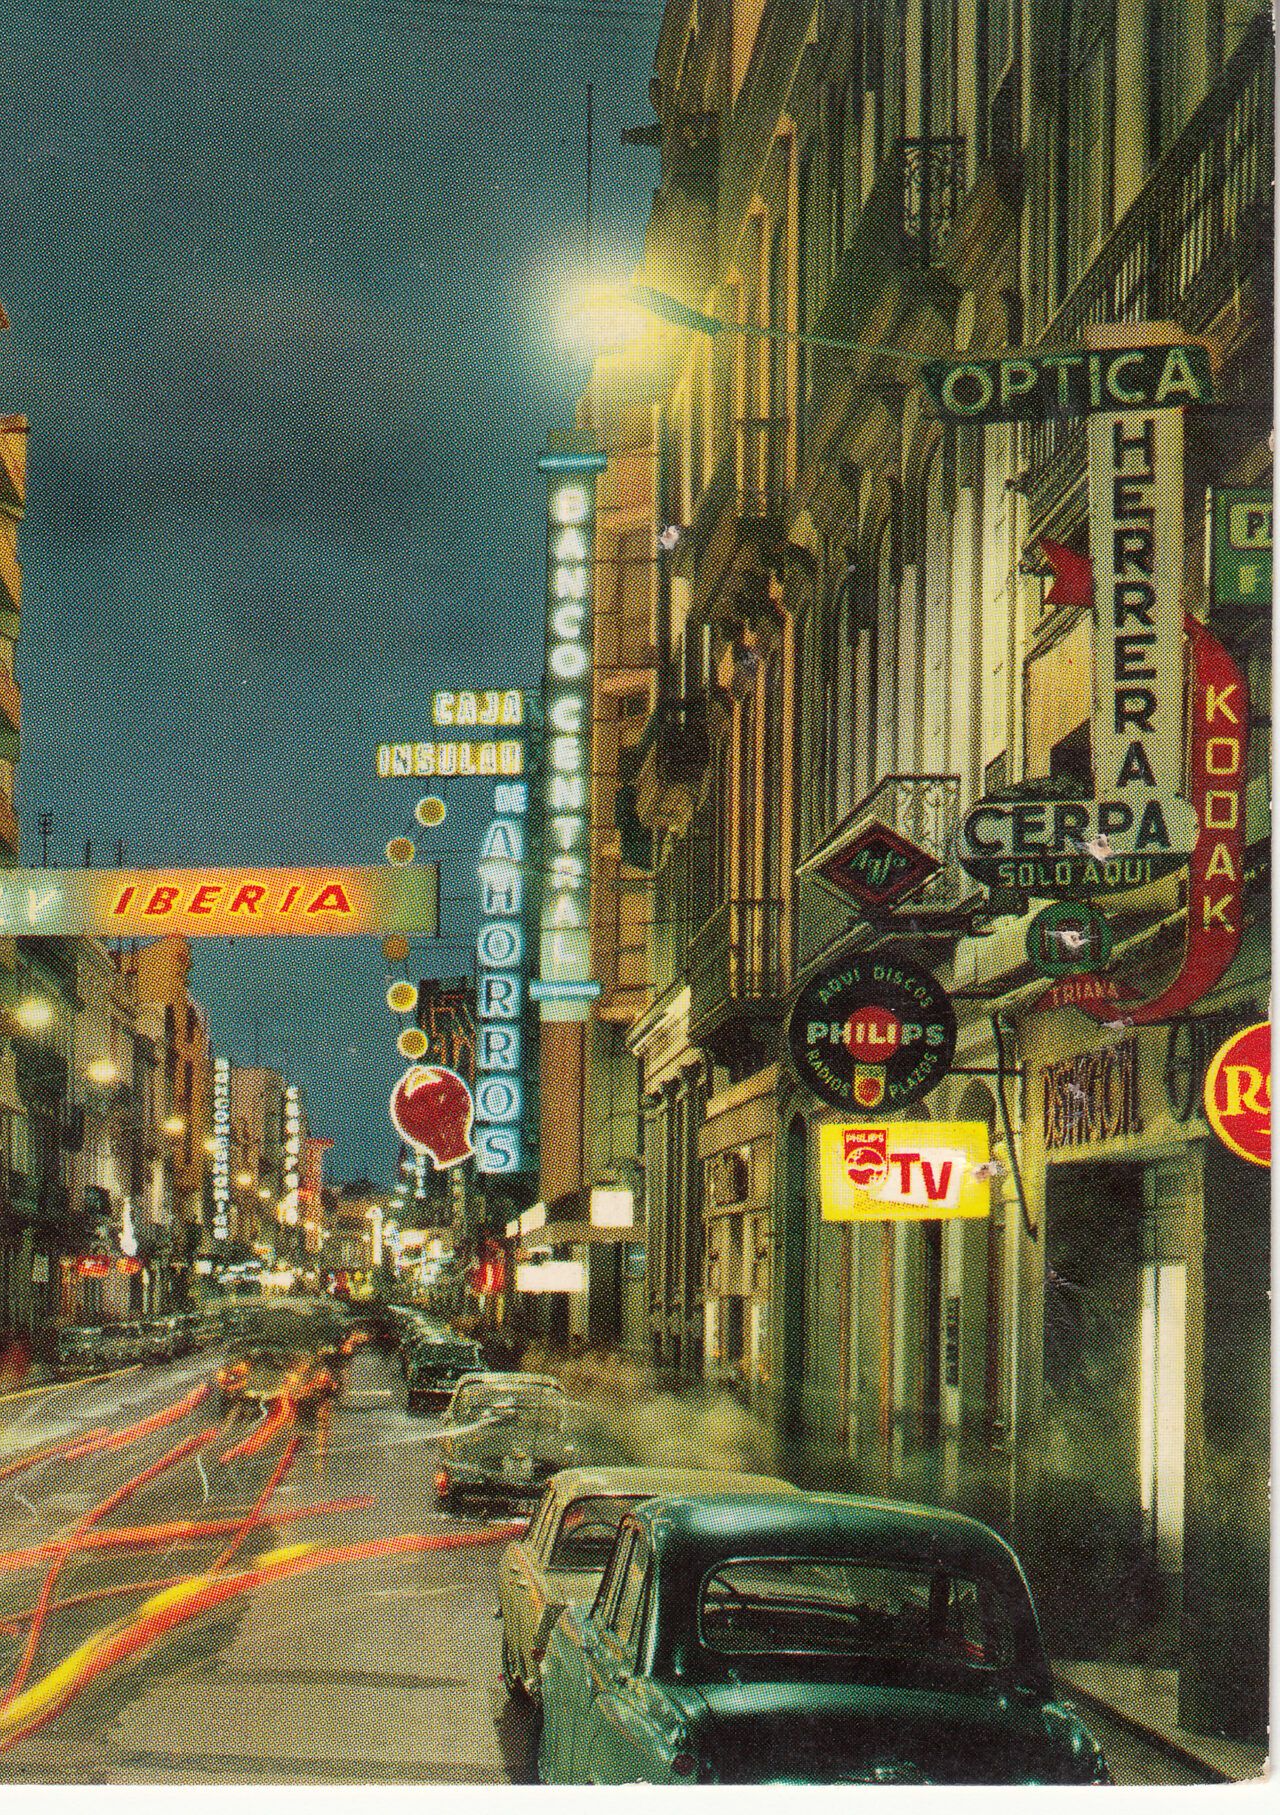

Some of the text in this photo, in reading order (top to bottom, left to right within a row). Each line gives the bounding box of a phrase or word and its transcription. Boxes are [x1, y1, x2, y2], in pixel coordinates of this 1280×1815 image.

[941, 348, 1202, 416] OPTICA
[1113, 419, 1158, 788] HERRERA
[432, 688, 524, 726] CAJA
[549, 484, 590, 962] BANCO CENTRAL
[376, 740, 524, 777] INSULAR
[965, 801, 1172, 853] CERPA
[1201, 684, 1239, 933] KODAK
[998, 858, 1152, 886] SOLO AQUI
[111, 882, 356, 919] IBERIA
[475, 816, 526, 1175] AHORROS
[818, 962, 934, 1008] AQUI DISCOS
[1051, 980, 1120, 1007] TRIANA
[806, 1020, 945, 1046] PHILIPS
[1219, 1064, 1272, 1117] R
[845, 1132, 885, 1144] PHILIPS
[889, 1152, 953, 1201] TV
